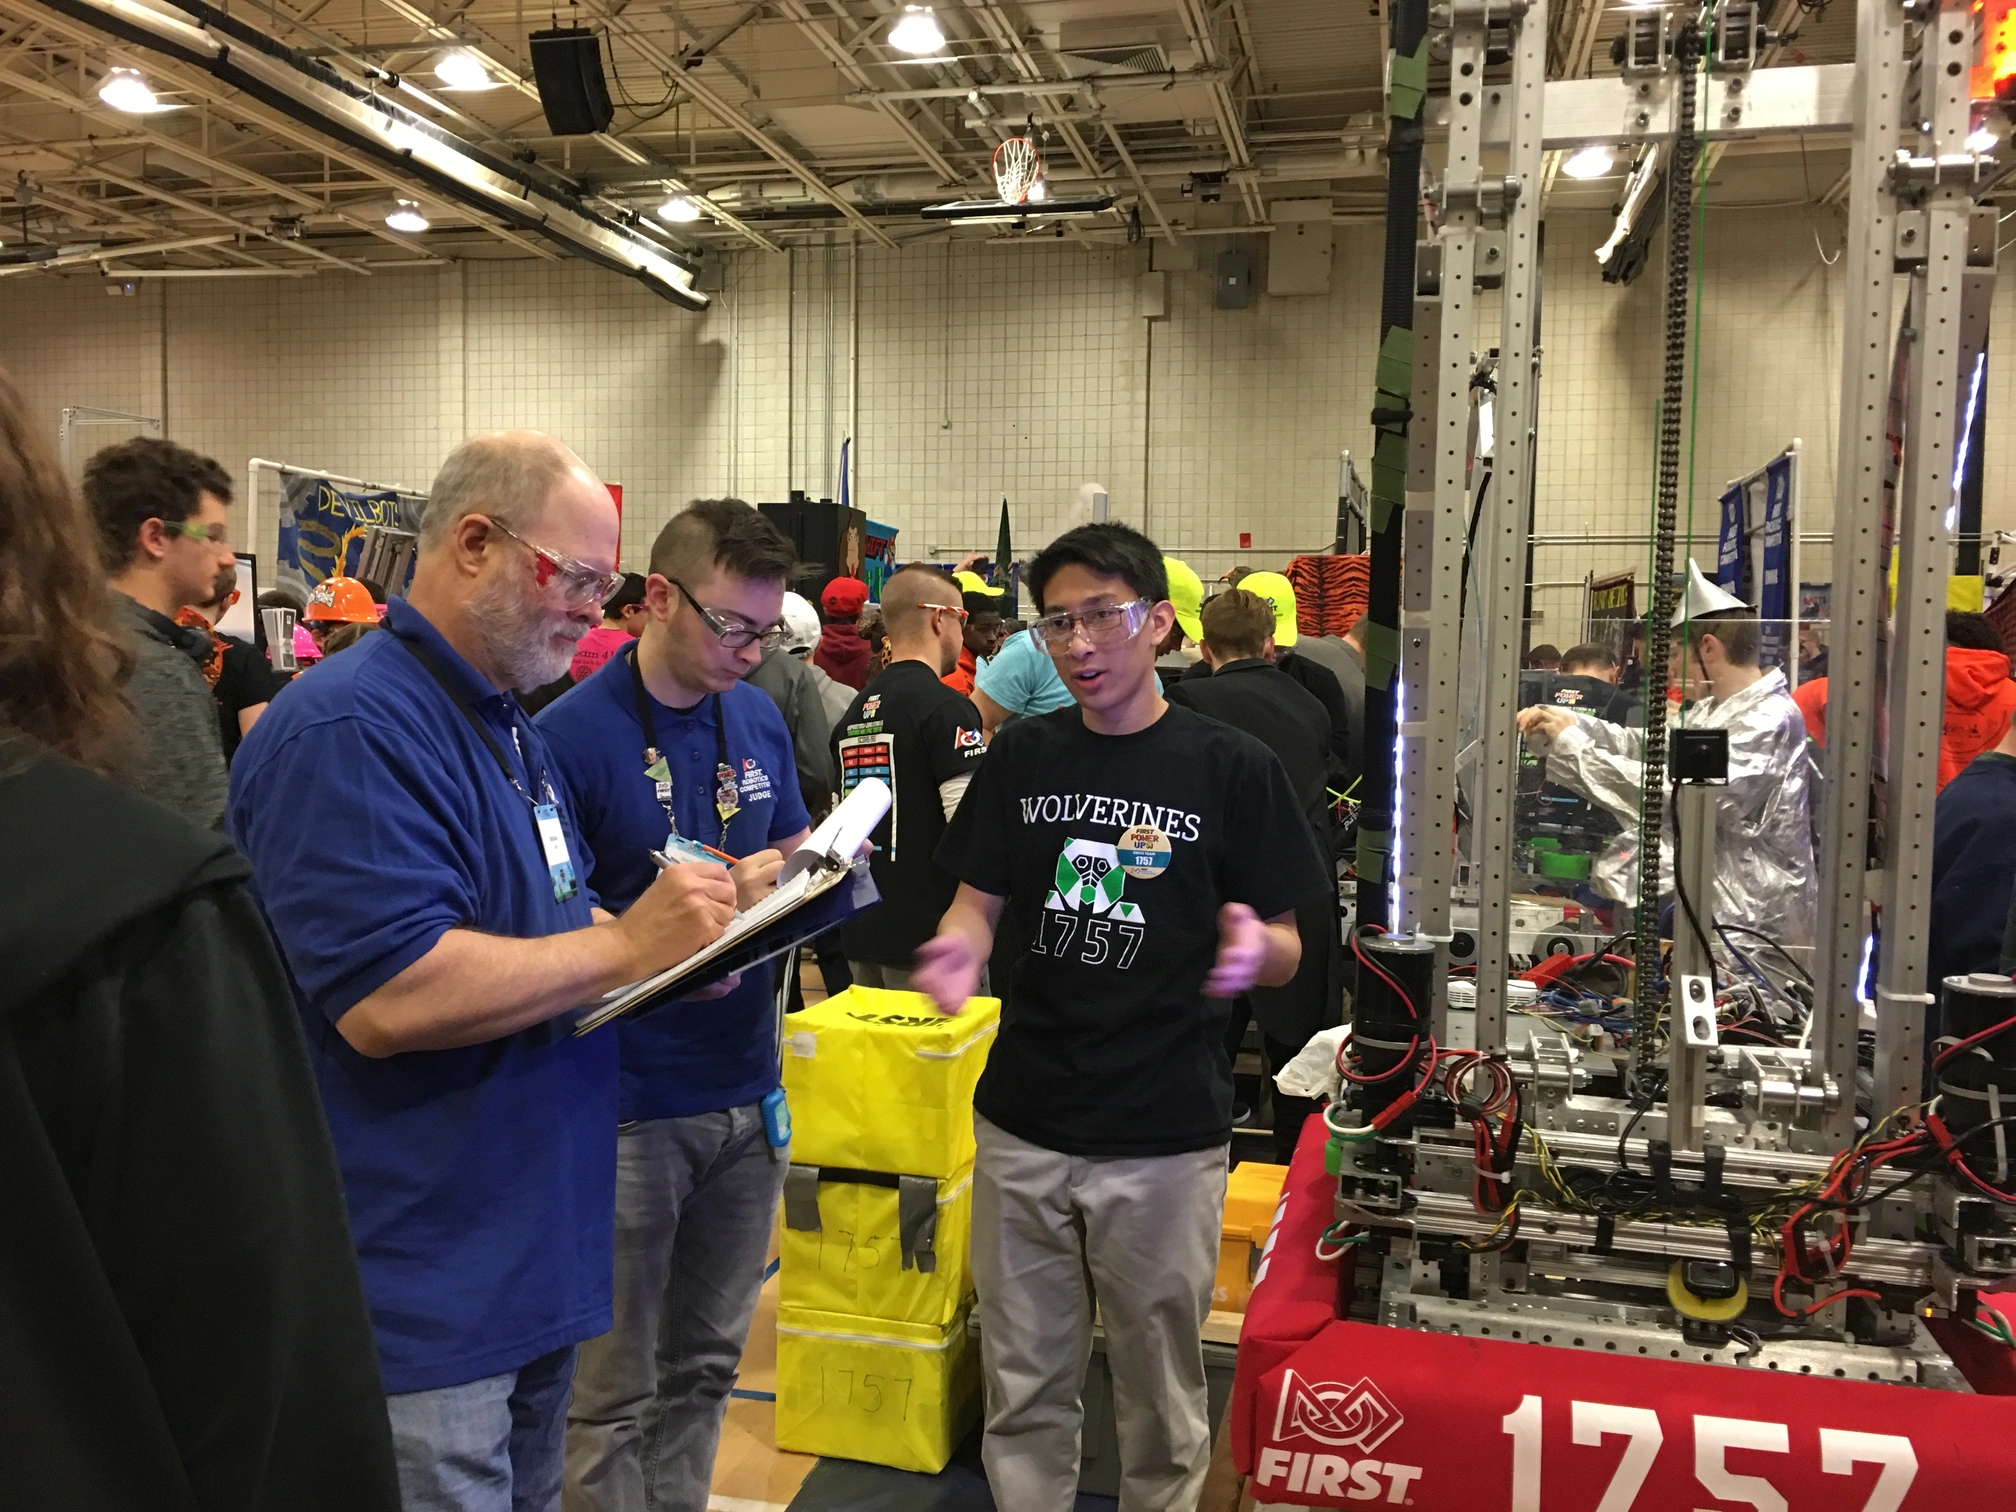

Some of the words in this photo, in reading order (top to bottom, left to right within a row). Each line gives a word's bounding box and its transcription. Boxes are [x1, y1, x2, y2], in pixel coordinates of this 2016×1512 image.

[1554, 691, 1584, 701] POWER
[1560, 688, 1581, 696] FIRST
[1556, 697, 1570, 705] UP
[964, 746, 988, 759] FIRS
[744, 768, 763, 779] FIRST
[741, 774, 769, 787] ROBOTICS
[748, 789, 772, 803] JUDGE
[1020, 793, 1202, 842] WOLVERINES
[1130, 833, 1160, 842] POWER
[1133, 841, 1146, 849] UP
[1134, 856, 1154, 866] 1757
[1031, 910, 1144, 970] 1757
[820, 1365, 912, 1422] 1757
[1502, 1394, 1920, 1512] 1757
[1256, 1446, 1424, 1505] FIRST
